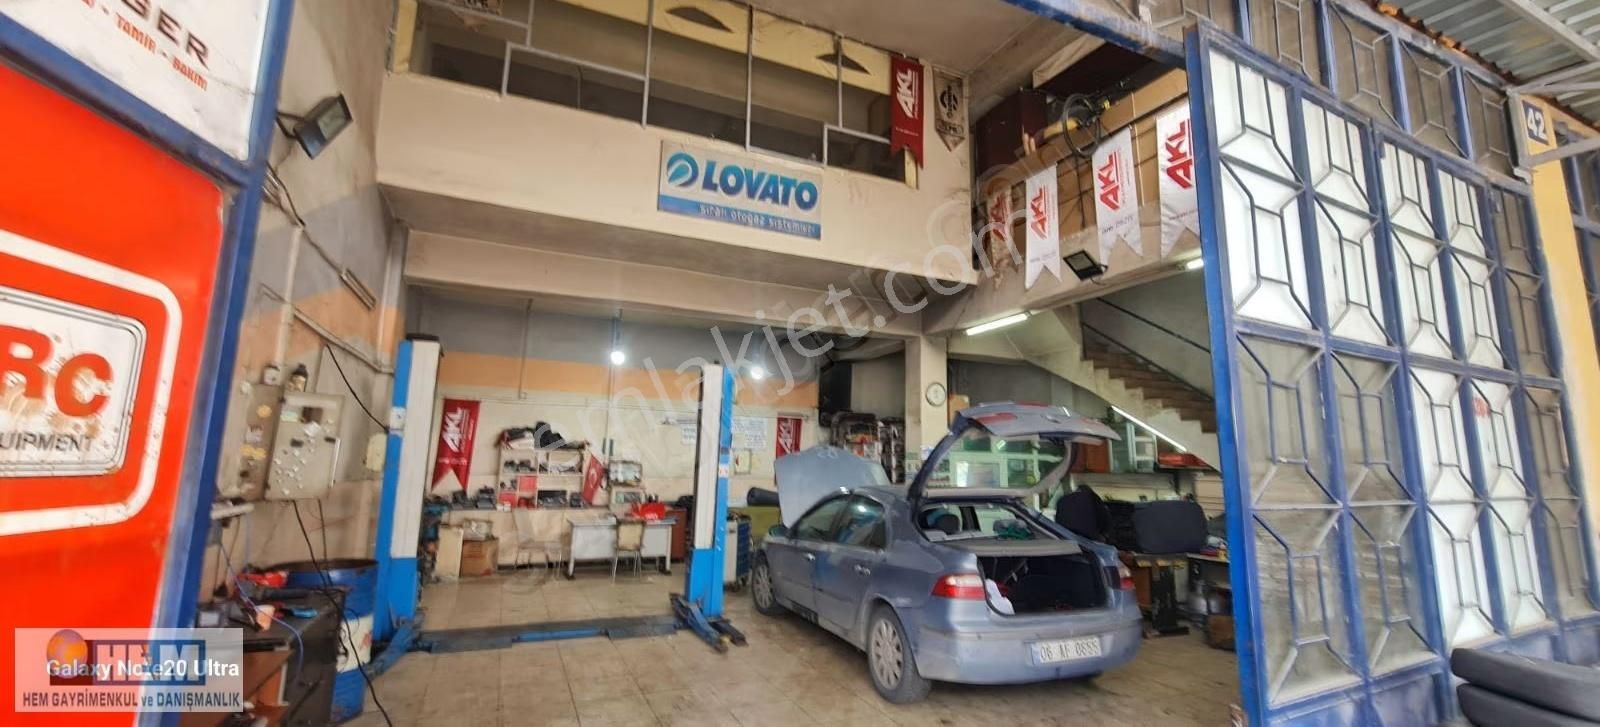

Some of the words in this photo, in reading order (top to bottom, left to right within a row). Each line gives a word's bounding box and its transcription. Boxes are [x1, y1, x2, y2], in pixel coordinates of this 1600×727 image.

[896, 69, 914, 118] AKL
[1528, 108, 1549, 139] 42
[1165, 120, 1193, 189] AKL
[702, 160, 818, 211] LOVATO
[1098, 153, 1120, 211] AKL
[1030, 186, 1047, 240] AKL
[441, 407, 463, 453] AKL
